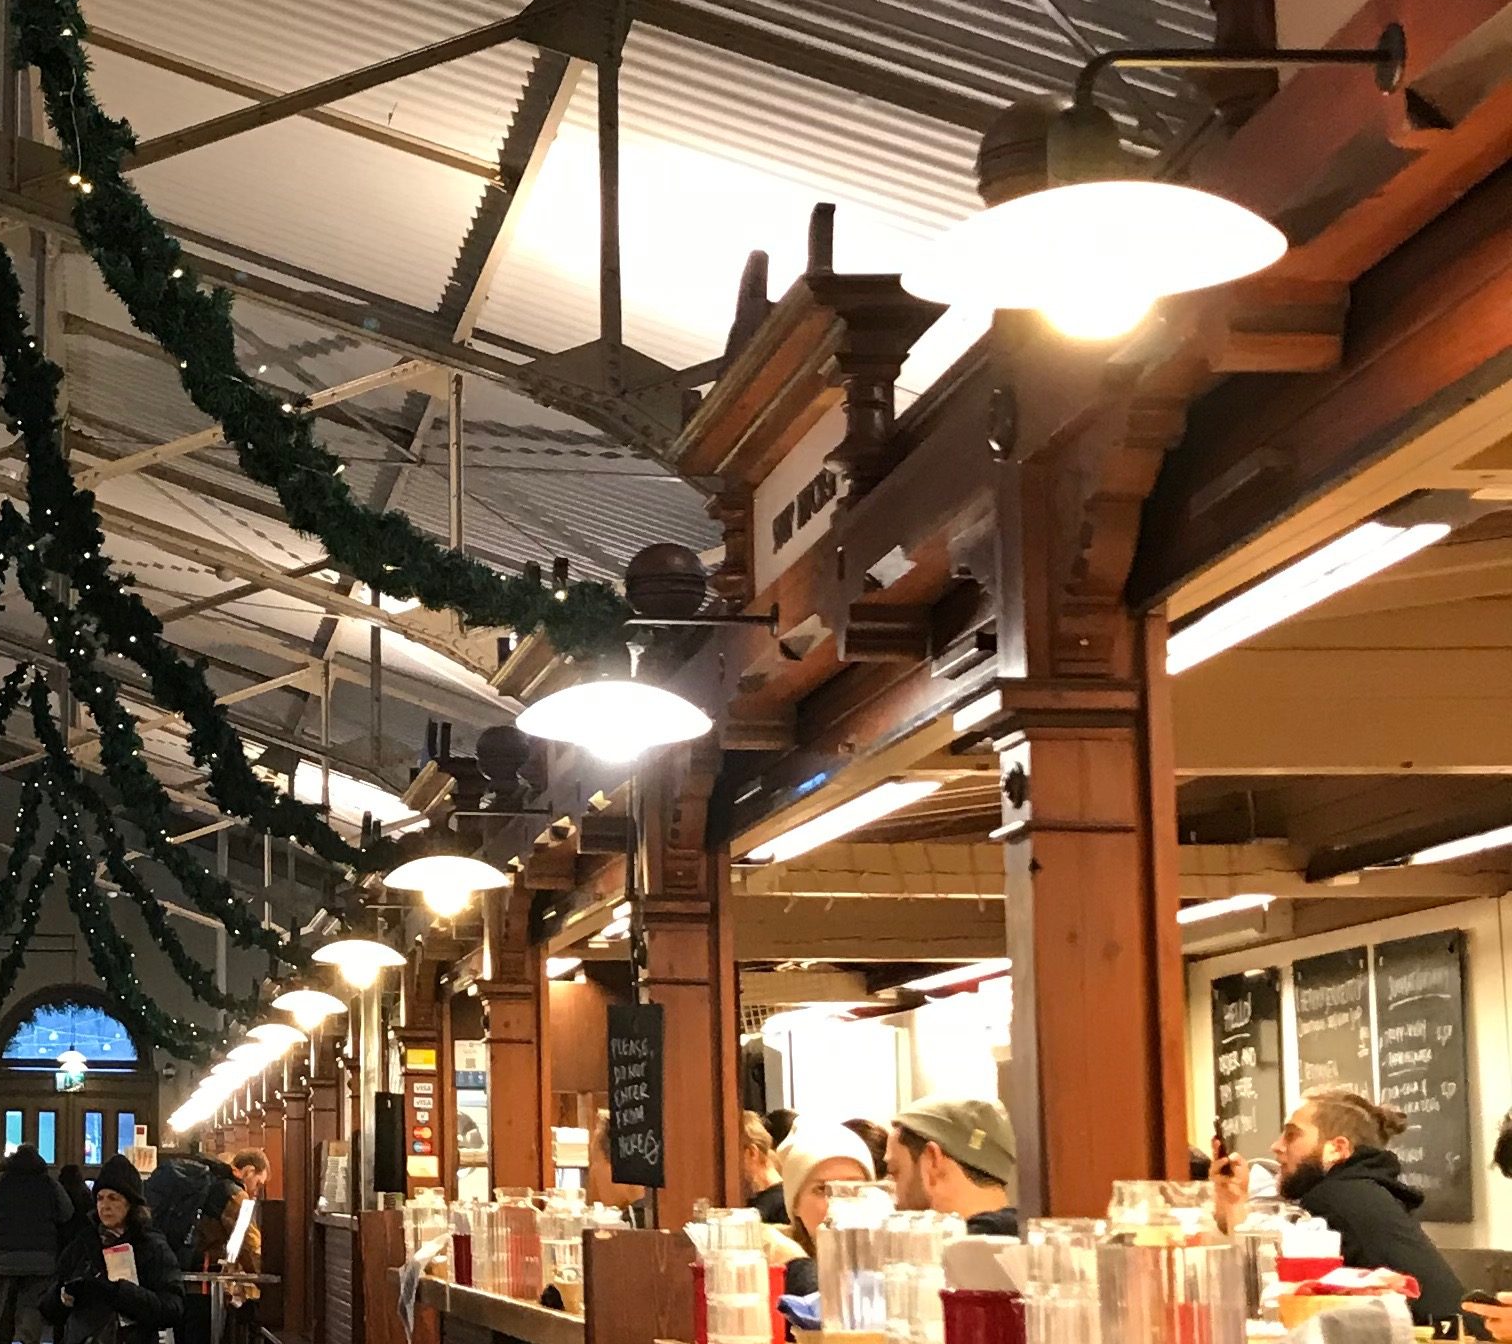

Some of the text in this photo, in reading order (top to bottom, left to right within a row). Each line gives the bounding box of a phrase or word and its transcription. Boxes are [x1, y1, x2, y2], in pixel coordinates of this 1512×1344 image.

[614, 1083, 649, 1107] ENTER
[615, 1105, 645, 1129] FROM
[1440, 1321, 1451, 1334] 7
